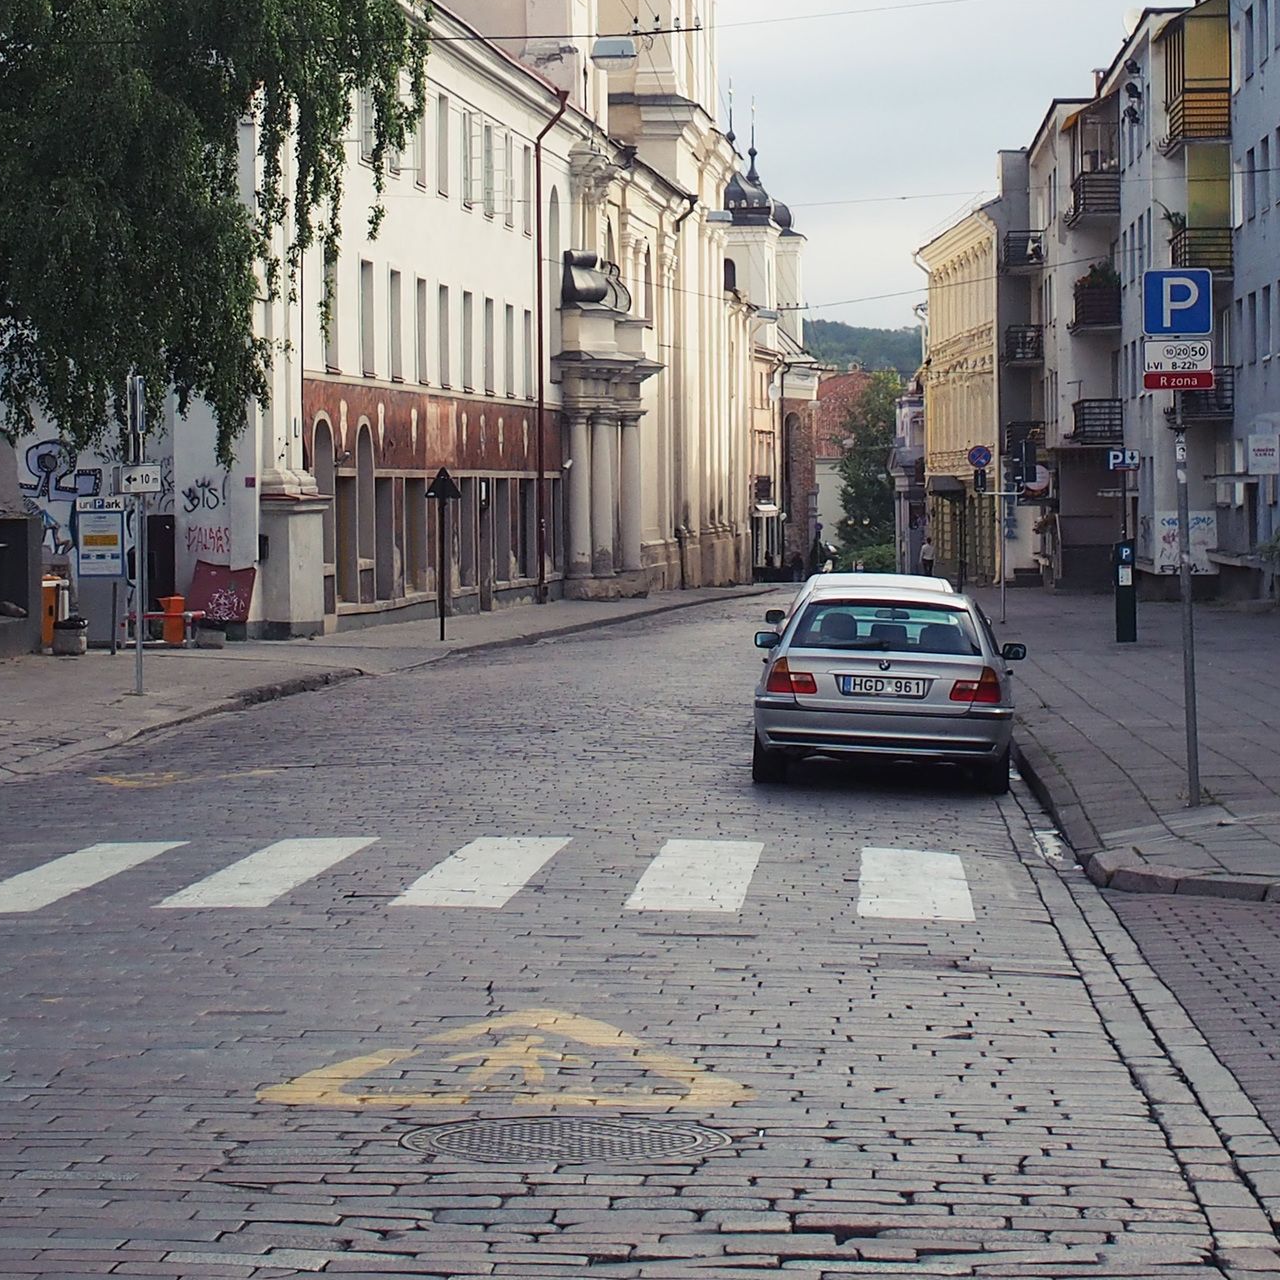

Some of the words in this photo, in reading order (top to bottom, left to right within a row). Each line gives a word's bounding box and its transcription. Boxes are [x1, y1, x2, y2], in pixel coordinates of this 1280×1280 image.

[1162, 276, 1200, 328] P
[1165, 348, 1174, 356] 10
[1176, 347, 1188, 357] 20
[1190, 346, 1206, 357] 50
[1147, 361, 1163, 371] I-VI
[1160, 376, 1168, 387] R
[1170, 377, 1198, 387] zona
[1109, 450, 1124, 471] P
[140, 473, 150, 485] 10
[152, 477, 159, 485] m
[1122, 548, 1131, 560] P
[852, 678, 885, 693] HGD
[894, 680, 920, 694] 961
